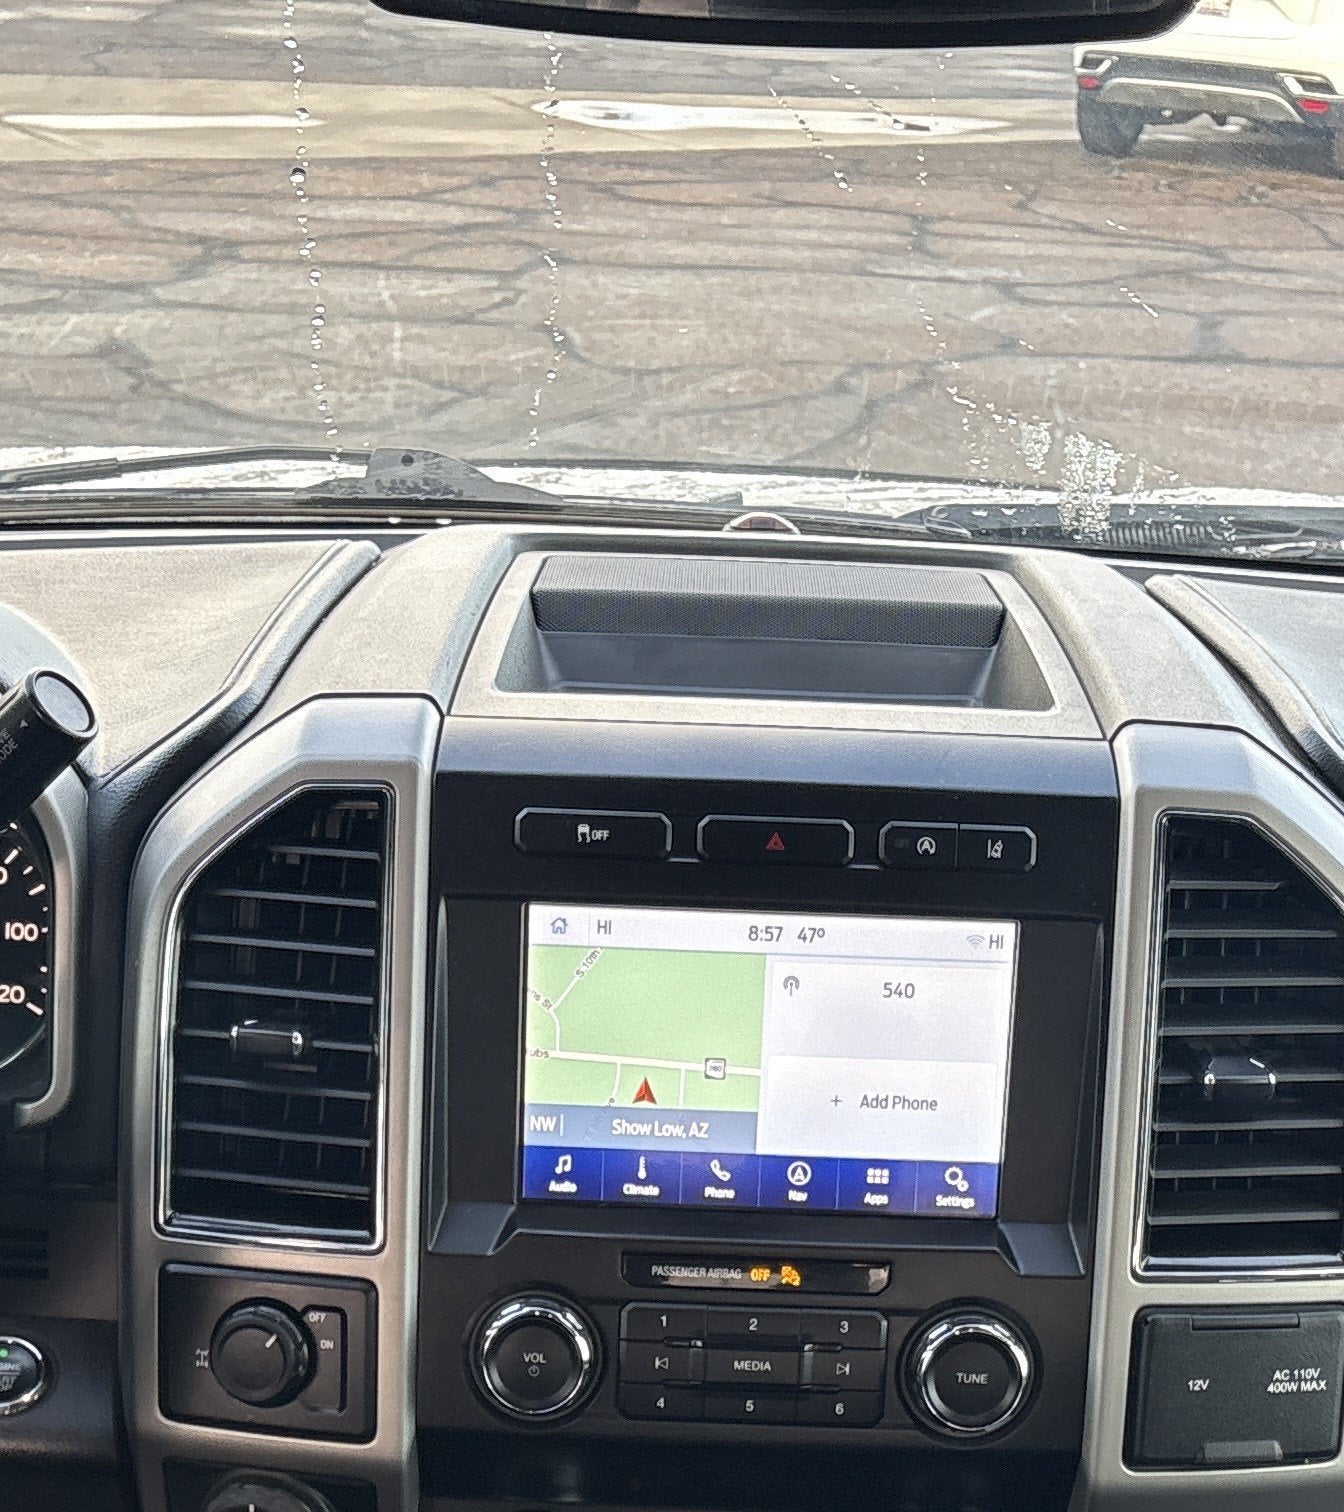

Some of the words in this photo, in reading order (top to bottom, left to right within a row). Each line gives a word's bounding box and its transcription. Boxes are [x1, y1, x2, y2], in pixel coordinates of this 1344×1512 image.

[591, 826, 610, 841] OFF
[4, 920, 39, 942] 100
[597, 919, 612, 936] HI
[748, 925, 784, 943] 8:57
[989, 933, 1005, 950] HI
[882, 982, 916, 1000] 540
[860, 1093, 888, 1110] Add
[892, 1096, 938, 1111] Phone
[529, 1116, 557, 1132] NW
[612, 1119, 652, 1136] Show
[654, 1121, 686, 1139] Low,
[688, 1122, 709, 1138] AZ
[549, 1180, 578, 1193] Audio
[622, 1183, 660, 1197] Climate
[704, 1187, 735, 1199] Phone
[788, 1189, 808, 1202] Nav
[864, 1191, 889, 1206] Apps
[936, 1194, 975, 1209] Settings
[651, 1265, 706, 1278] PASSENGER
[706, 1268, 742, 1279] AIRBAG
[750, 1268, 771, 1282] OFF
[309, 1312, 326, 1323] OFF
[660, 1315, 667, 1328] 1
[748, 1318, 758, 1331] 2
[839, 1320, 849, 1333] 3
[320, 1340, 334, 1350] ON
[523, 1352, 546, 1364] VOL
[733, 1360, 772, 1372] MEDIA
[956, 1373, 988, 1385] TUNE
[1272, 1369, 1290, 1381] AC
[1293, 1368, 1321, 1380] 110V
[1187, 1379, 1210, 1391] 12V
[1266, 1381, 1299, 1393] 400W
[1300, 1379, 1327, 1392] MAX
[656, 1397, 665, 1409] 4
[745, 1400, 754, 1413] 5
[835, 1403, 845, 1415] 6
